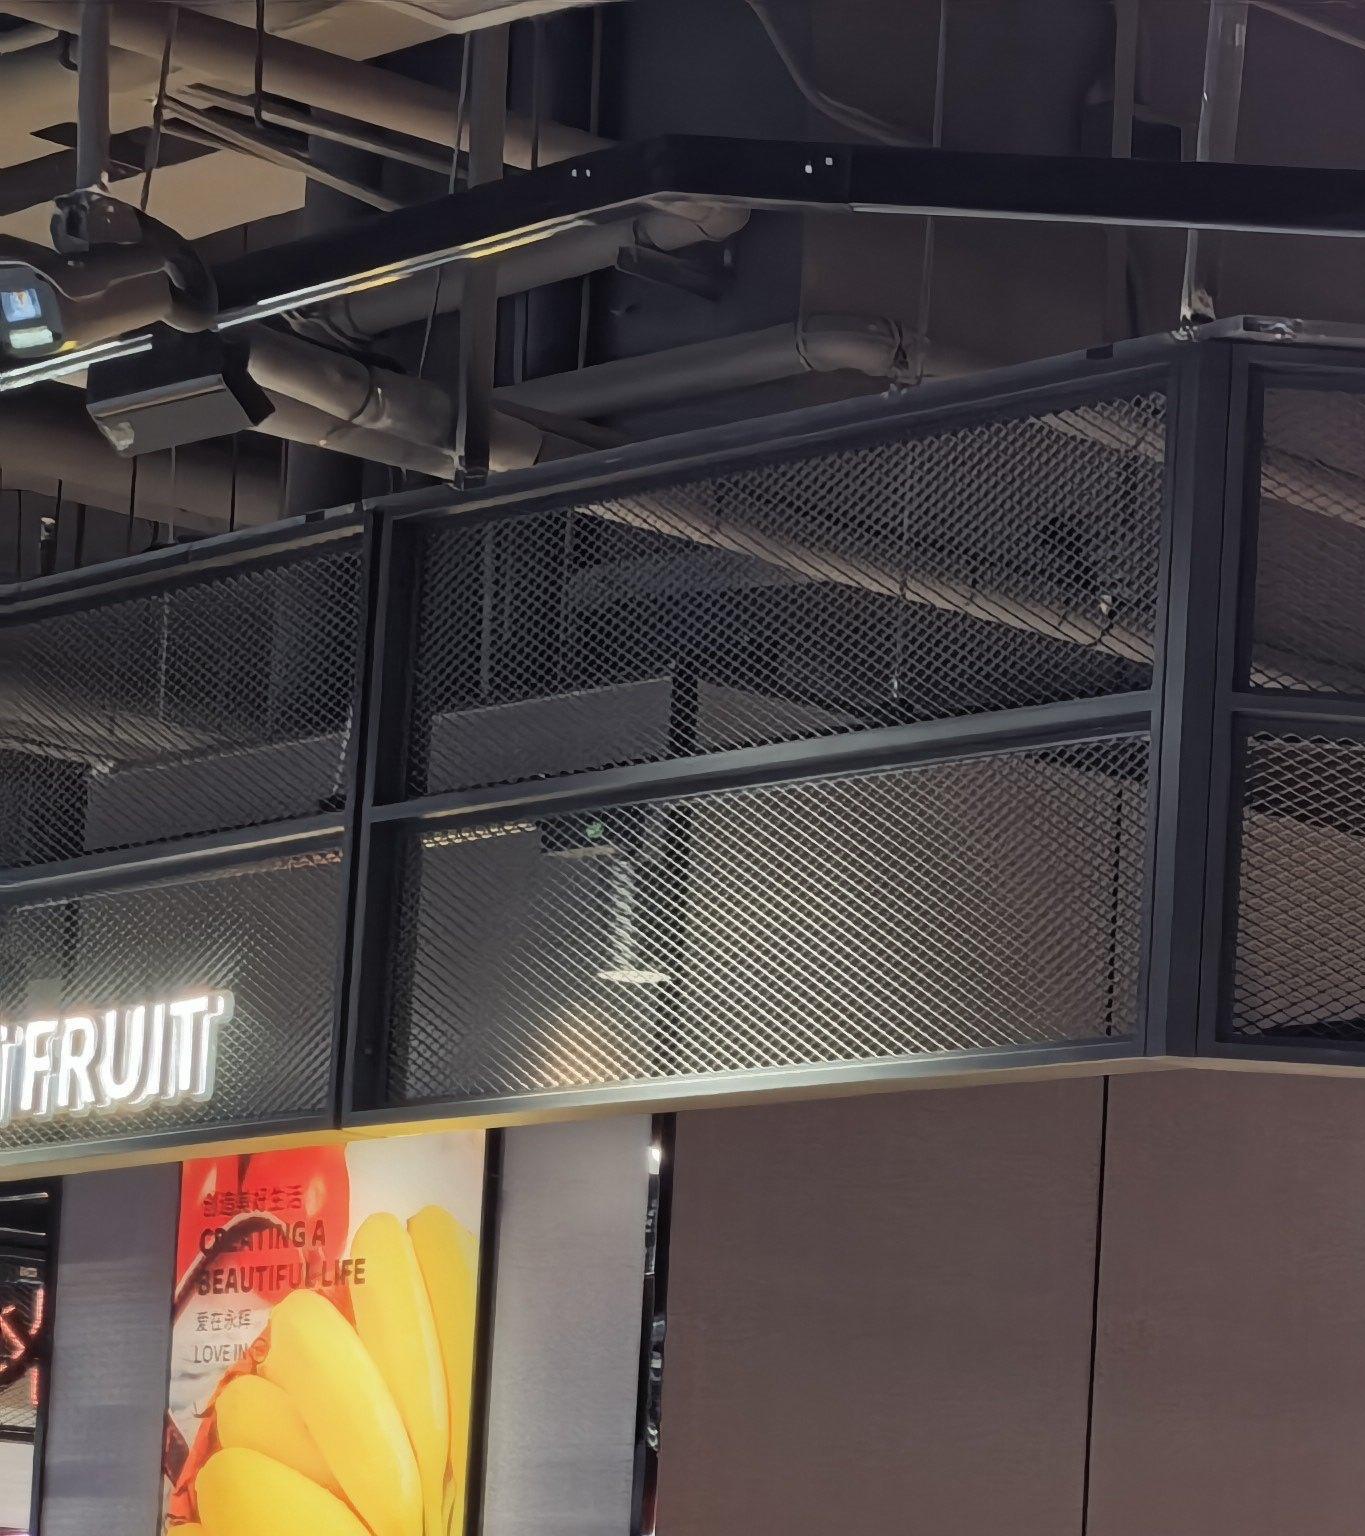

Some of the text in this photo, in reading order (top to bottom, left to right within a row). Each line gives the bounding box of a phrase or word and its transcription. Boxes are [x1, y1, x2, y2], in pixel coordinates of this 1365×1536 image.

[20, 991, 228, 1114] FRUIT
[199, 1220, 326, 1252] CRATING A
[197, 1258, 366, 1296] BEAUTIFUL LIFE
[194, 1344, 232, 1364] LOVE
